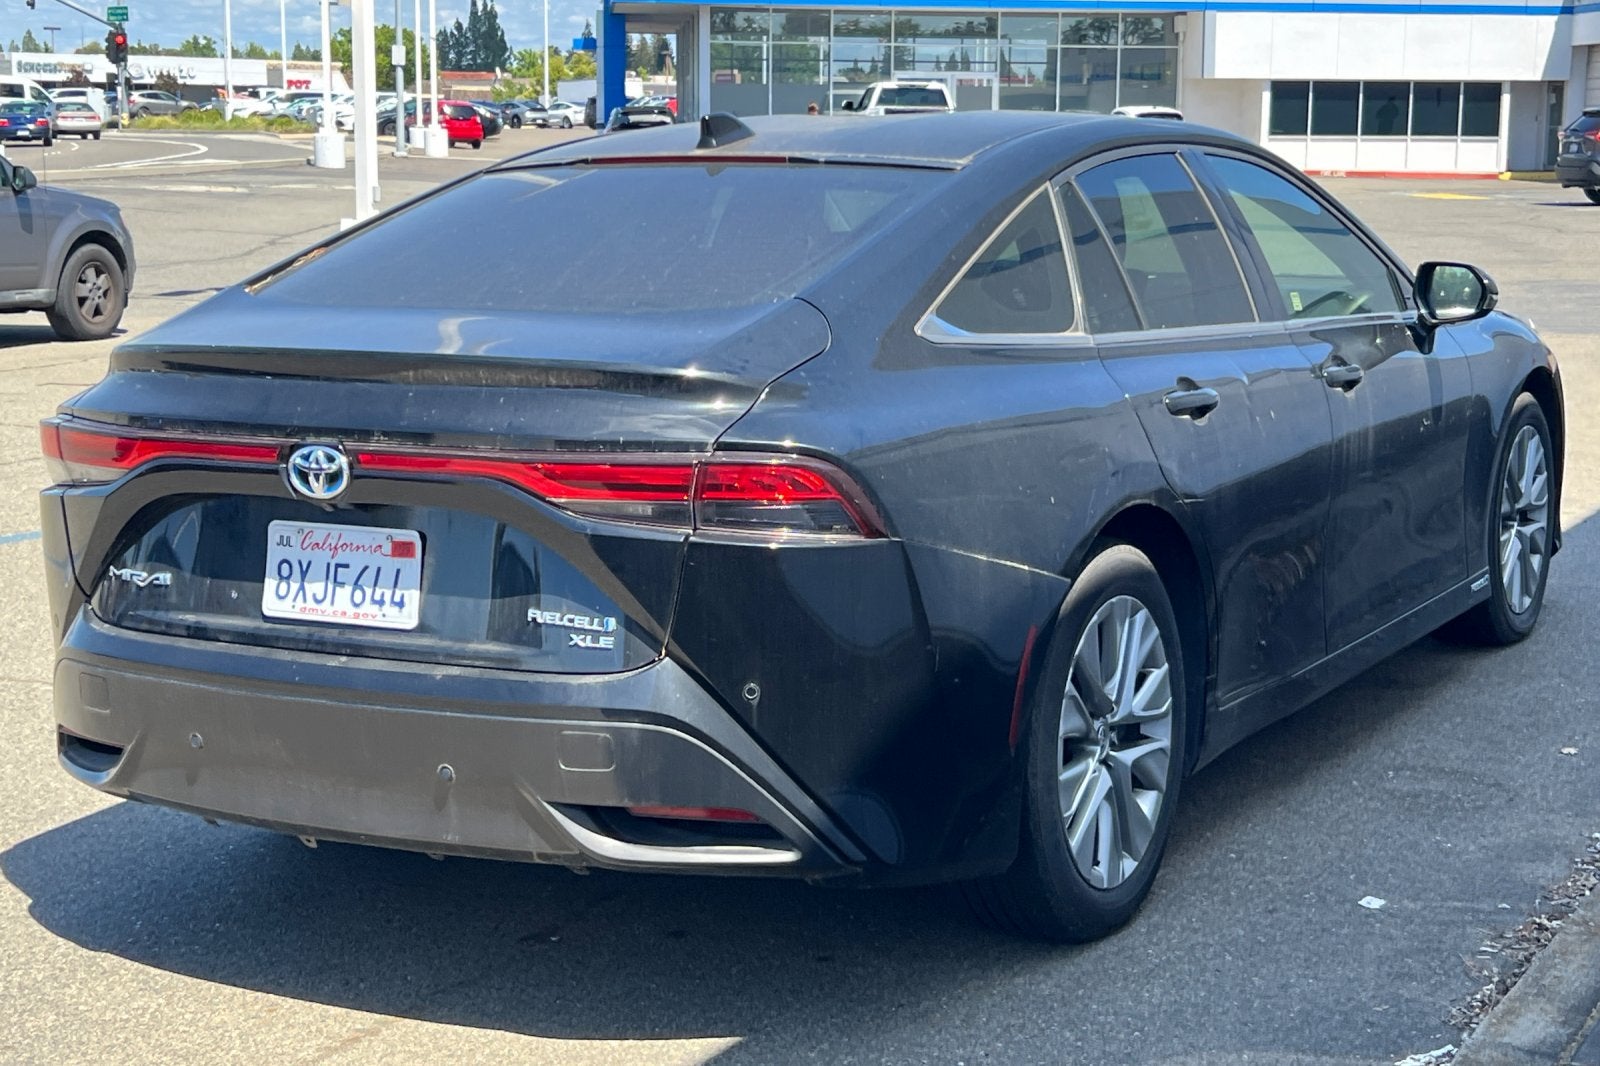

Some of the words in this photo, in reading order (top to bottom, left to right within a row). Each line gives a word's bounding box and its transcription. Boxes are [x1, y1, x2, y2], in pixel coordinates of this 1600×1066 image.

[276, 534, 293, 548] JUL
[301, 530, 392, 559] California
[275, 558, 406, 610] 8XJF644
[299, 605, 379, 620] dmv.ca.gov
[568, 633, 615, 649] XLE
